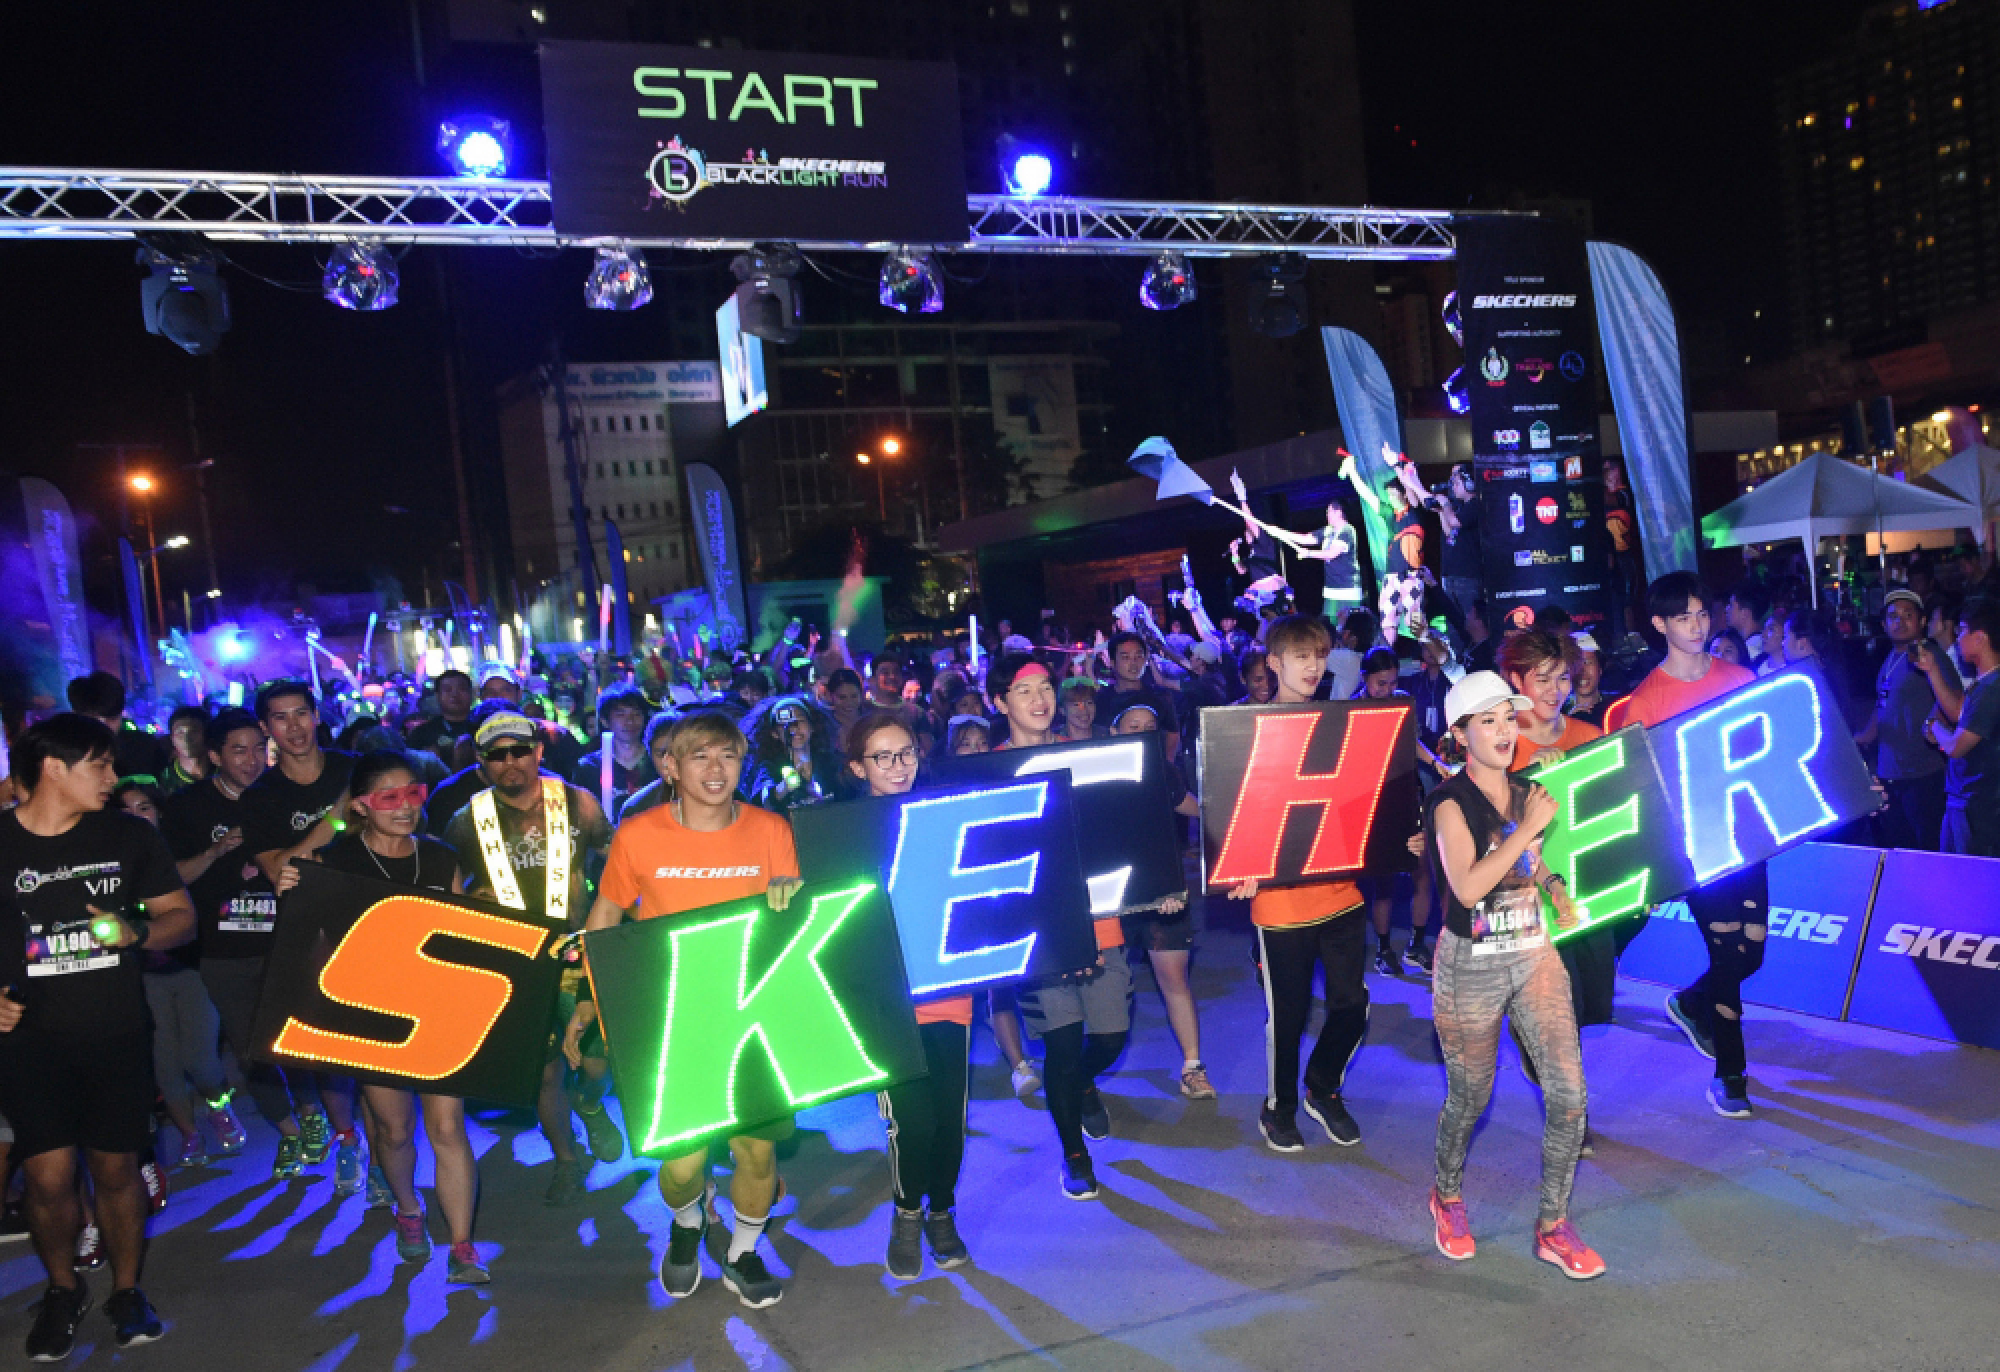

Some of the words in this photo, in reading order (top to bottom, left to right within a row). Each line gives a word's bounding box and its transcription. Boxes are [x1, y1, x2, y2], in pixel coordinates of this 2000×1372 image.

[633, 66, 879, 128] START
[843, 172, 889, 189] RUN
[1472, 294, 1577, 309] SKECHERS
[1209, 704, 1410, 886] H
[1528, 737, 1651, 944] E
[1676, 673, 1839, 884] R
[84, 877, 122, 896] VIP
[654, 865, 761, 879] SKECHERS
[887, 780, 1049, 996] E
[270, 894, 551, 1081] S
[640, 882, 890, 1153] K
